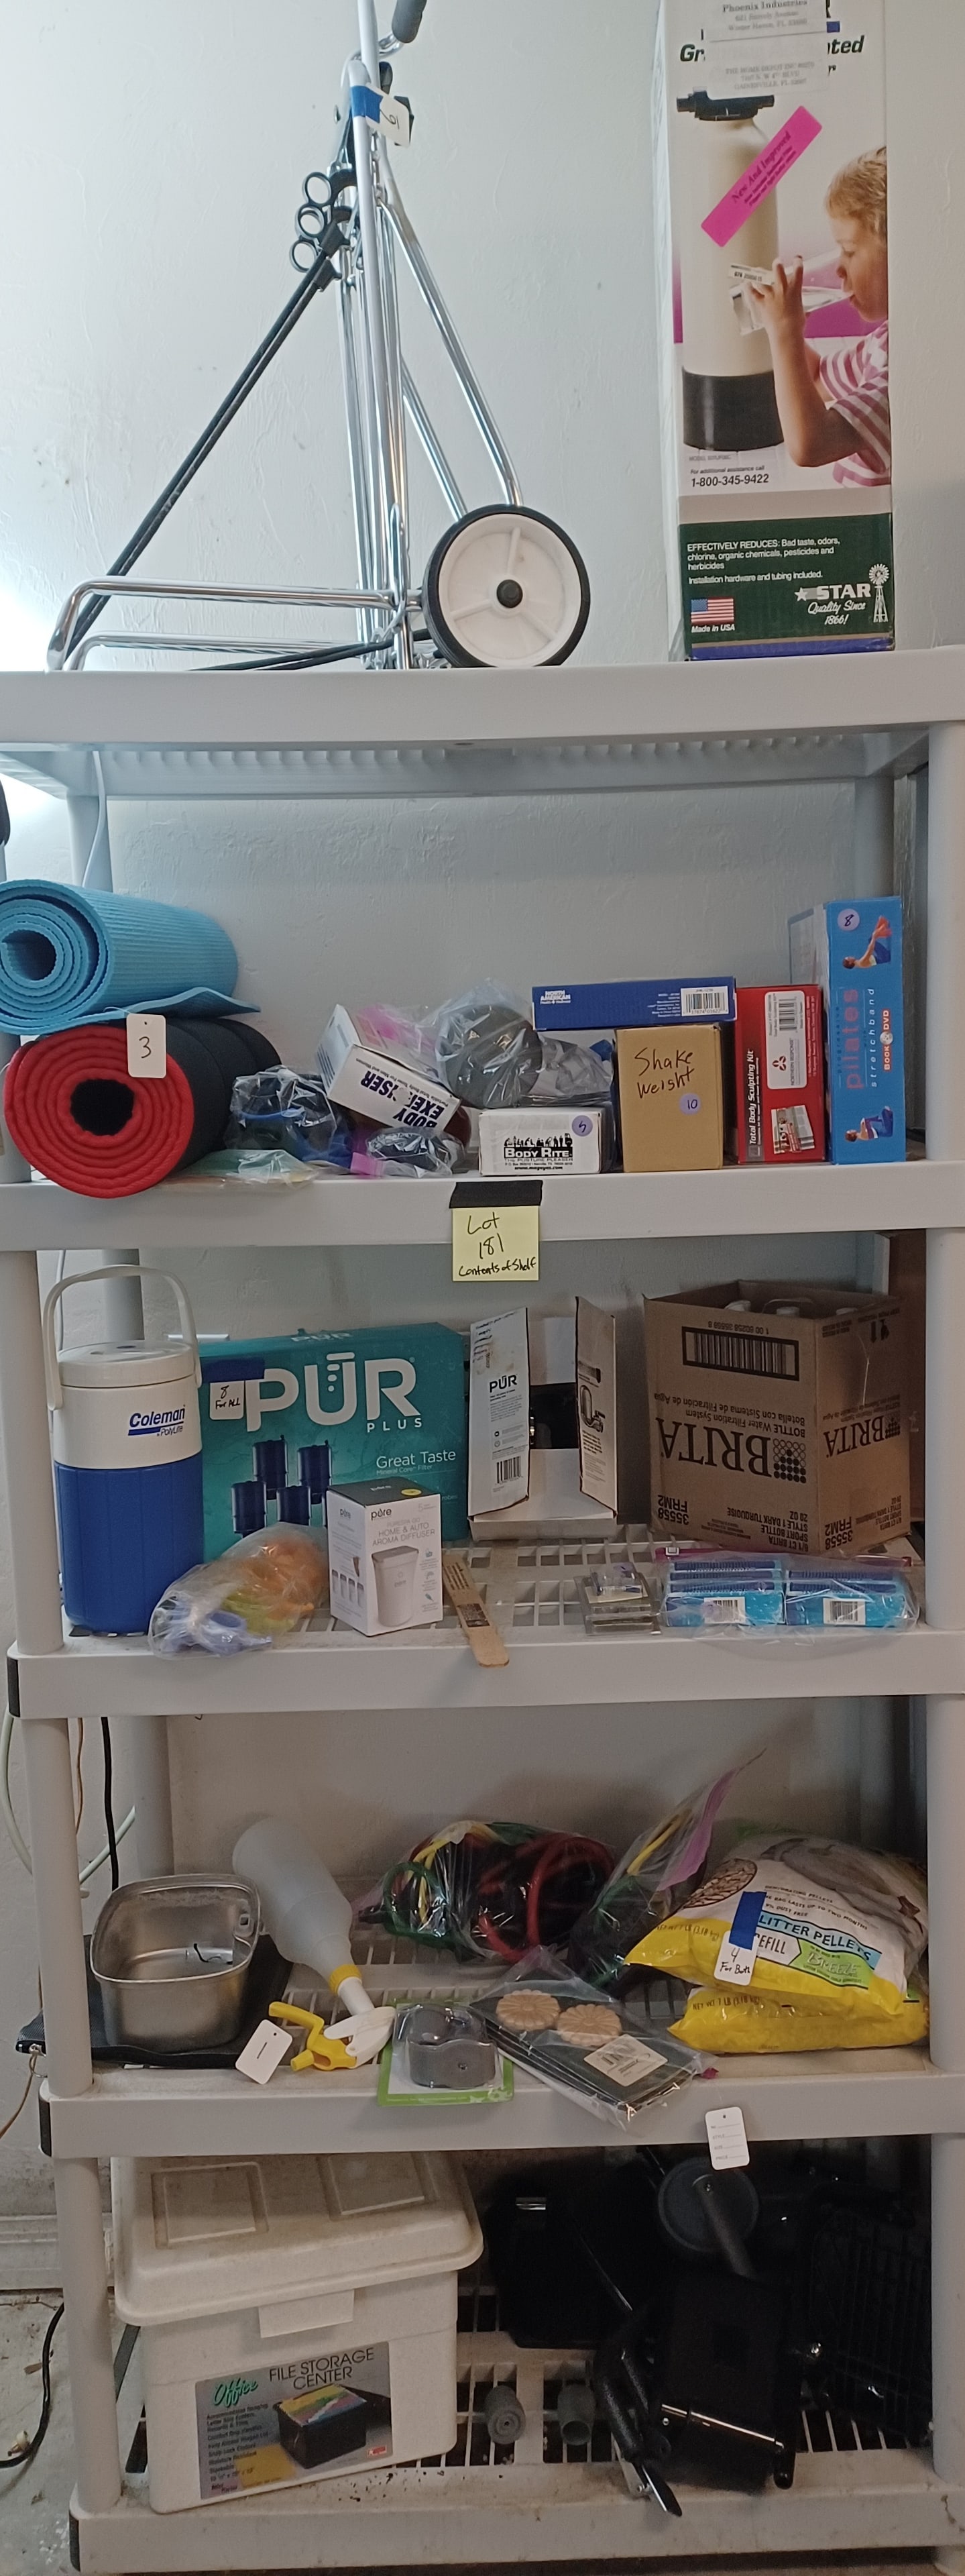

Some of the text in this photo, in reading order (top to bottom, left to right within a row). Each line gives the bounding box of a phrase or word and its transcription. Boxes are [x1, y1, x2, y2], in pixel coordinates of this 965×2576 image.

[722, 3, 759, 13] Phoenix
[691, 473, 769, 487] 1-800-345-9422
[687, 542, 738, 552] EFFECTIVELY
[740, 539, 780, 549] REDUCES:
[781, 539, 796, 547] Bad
[817, 537, 840, 545] odors,
[687, 547, 834, 561] chlorine, organic chemicals, pesticides and
[688, 562, 724, 570] herbicides
[756, 573, 771, 582] and
[771, 572, 792, 581] tubing
[816, 582, 871, 600] STAR
[807, 600, 866, 615] Quality Since
[824, 614, 849, 626] 1866!
[691, 625, 711, 633] Made
[720, 624, 736, 632] USA
[844, 914, 854, 926] 8
[842, 989, 864, 1089] pilates
[868, 988, 877, 1087] stretchband
[139, 1036, 152, 1059] 3
[634, 1046, 693, 1076] Shake
[748, 1064, 756, 1102] Sculpting
[687, 1098, 698, 1110] 10
[748, 1103, 757, 1123] Body
[505, 1147, 538, 1158] BODY
[467, 1212, 500, 1235] Lot
[479, 1232, 504, 1259] 181
[459, 1256, 536, 1277] Contents of Shelf
[215, 1400, 227, 1409] For
[654, 1393, 671, 1405] Agua
[683, 1398, 717, 1411] Filtración
[129, 1407, 185, 1428] Coleman
[730, 1405, 760, 1419] Sistema
[762, 1411, 776, 1419] con
[778, 1413, 805, 1426] Botella
[367, 1418, 422, 1433] PLUS
[685, 1409, 805, 1438] BOTTLE Water Filtration System
[823, 1415, 885, 1458] BRITA
[655, 1417, 773, 1478] BRITA
[376, 1449, 456, 1469] Great Taste
[658, 1495, 688, 1513] FRM2
[659, 1507, 689, 1525] 35558
[727, 1507, 762, 1523] TURQUOISE
[763, 1514, 781, 1527] DARK
[789, 1511, 799, 1520] OZ
[378, 1527, 400, 1538] HOME
[410, 1522, 429, 1532] AUTO
[761, 1524, 785, 1538] BOTTLE
[787, 1519, 808, 1532] STYLE
[825, 1517, 852, 1536] FRM2
[372, 1529, 435, 1547] AROMA DIFFUSER
[769, 1535, 787, 1548] BRITA
[785, 1529, 808, 1542] SPORT
[825, 1529, 853, 1550] 35558
[776, 1904, 792, 1913] DUST
[828, 1909, 842, 1919] TWO
[843, 1916, 868, 1931] MONTHS
[758, 1914, 872, 1961] LITTER PELLETS
[731, 1947, 740, 1963] 4
[720, 1962, 750, 1975] For Both
[724, 1997, 732, 2006] LB
[269, 2347, 375, 2382] FILE STORAGE
[292, 2366, 353, 2390] CENTER
[213, 2377, 259, 2408] Office
